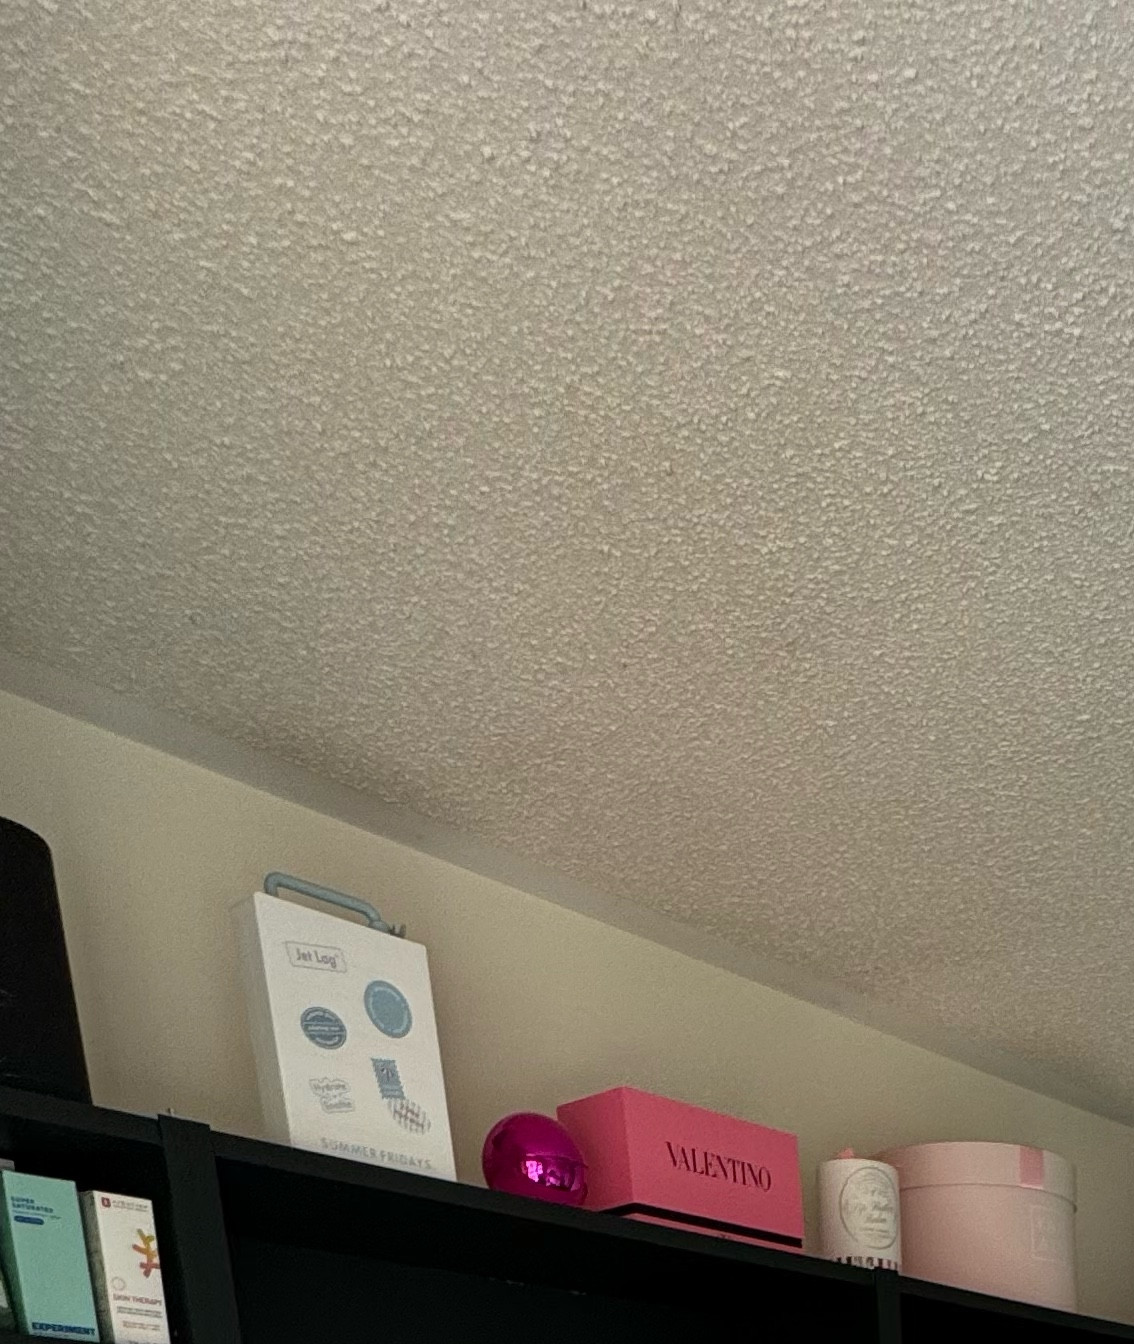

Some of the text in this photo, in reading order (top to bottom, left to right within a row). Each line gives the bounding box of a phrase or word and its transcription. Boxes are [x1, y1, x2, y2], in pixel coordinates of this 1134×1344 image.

[319, 1136, 432, 1170] SUMMER FRIDAYS
[664, 1140, 773, 1194] VALENTINO
